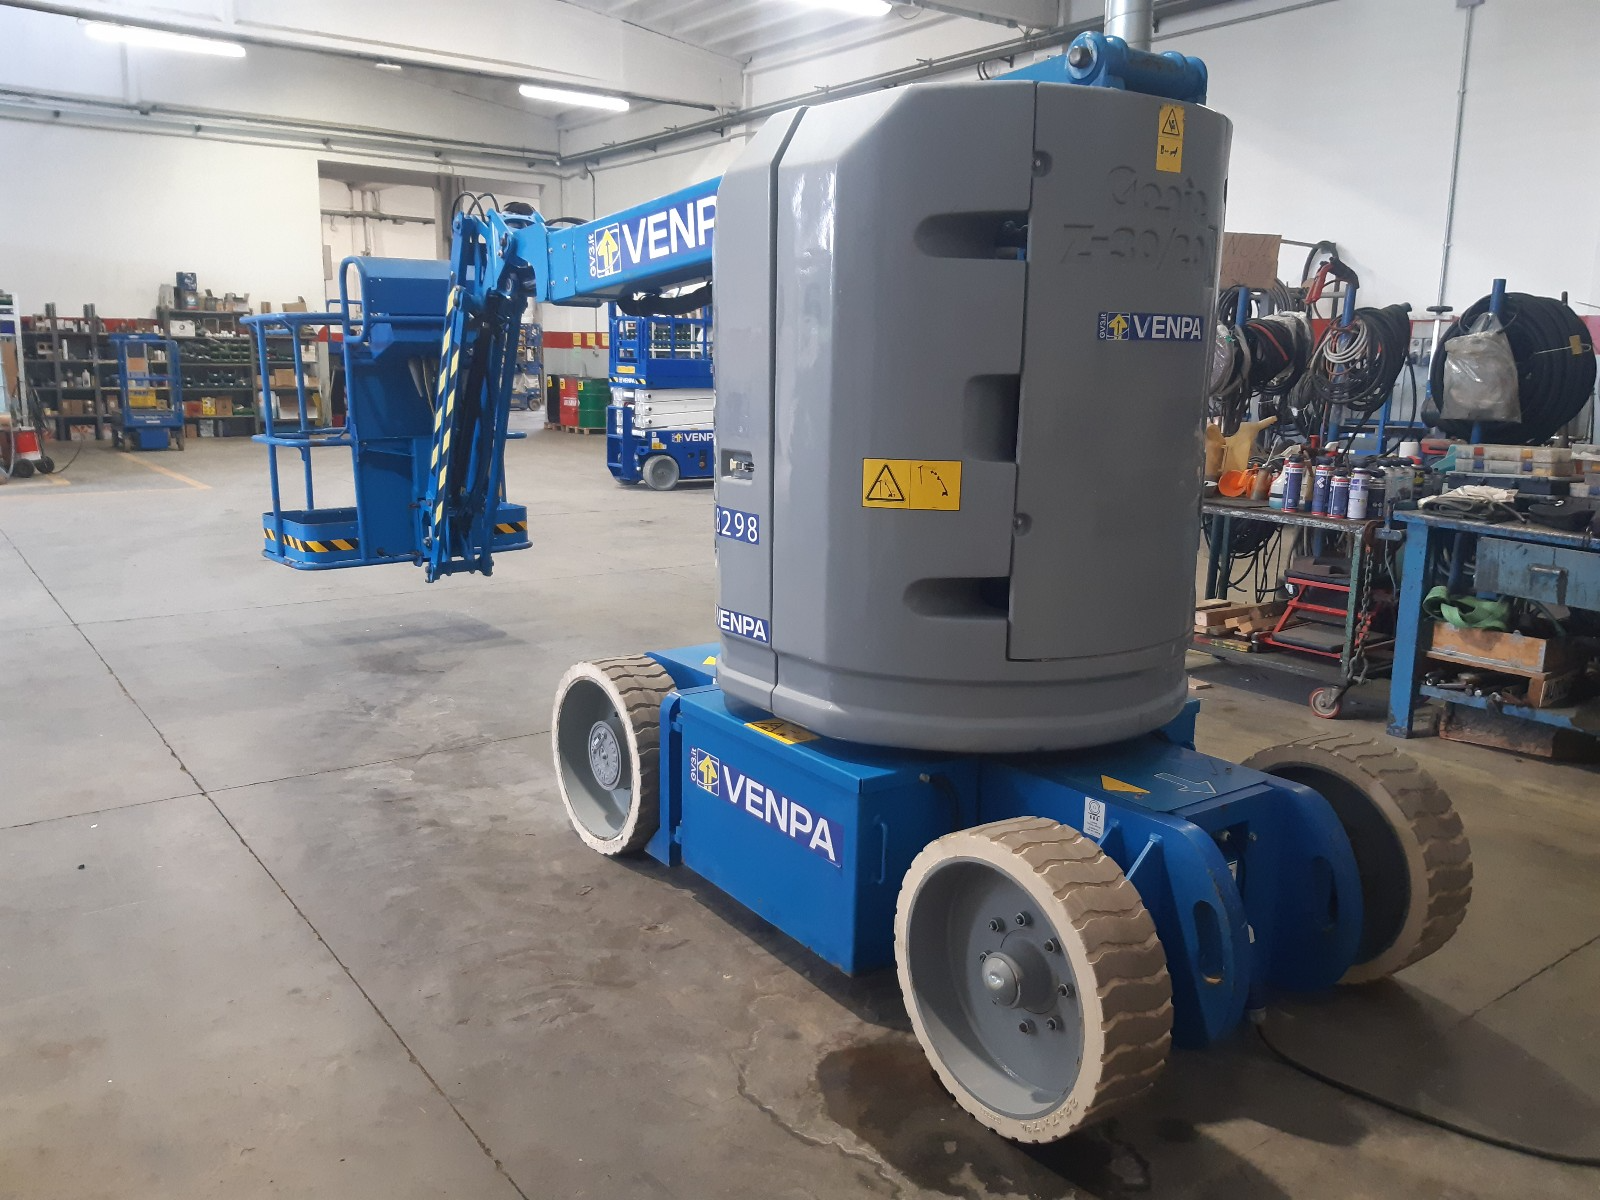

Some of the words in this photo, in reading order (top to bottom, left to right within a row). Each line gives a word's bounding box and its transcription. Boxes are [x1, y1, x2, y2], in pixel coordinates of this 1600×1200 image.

[587, 233, 597, 277] GV3.it
[1099, 313, 1107, 338] GV3.it
[1133, 315, 1202, 340] VENPA
[684, 432, 714, 442] VENP
[715, 605, 767, 642] VENPA
[723, 765, 836, 862] VENPA
